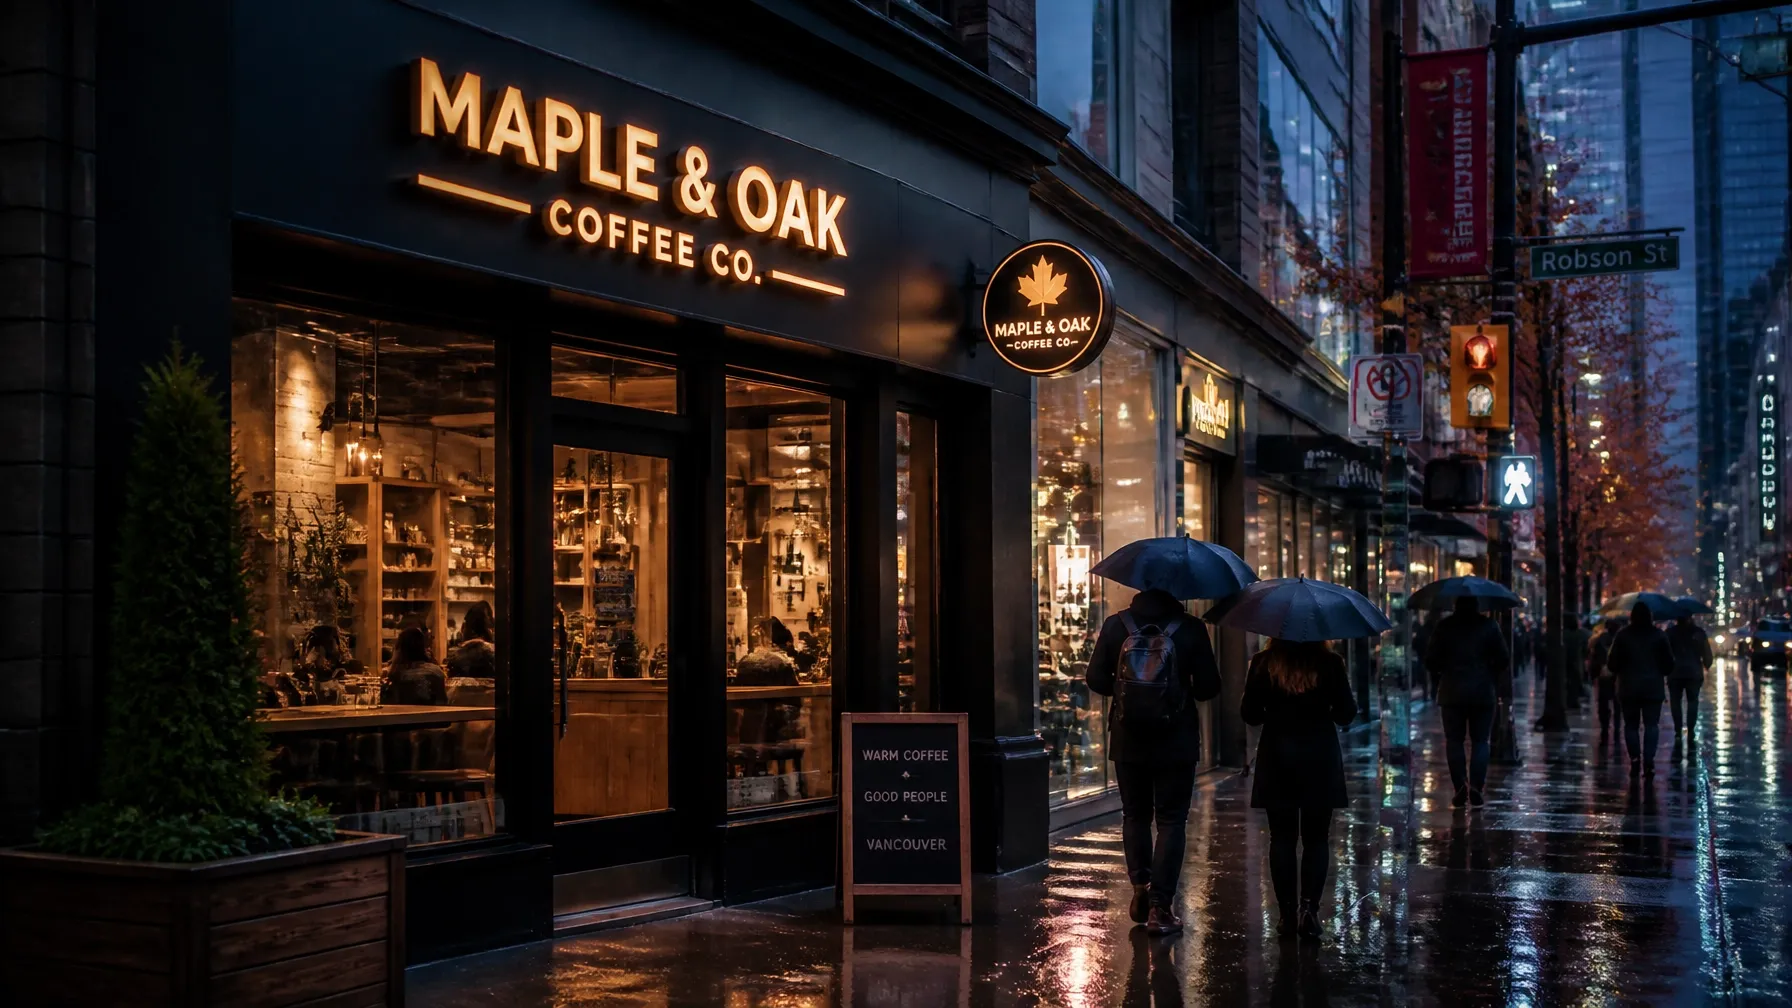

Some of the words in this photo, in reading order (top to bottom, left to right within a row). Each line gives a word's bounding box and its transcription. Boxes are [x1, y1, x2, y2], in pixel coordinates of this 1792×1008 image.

[418, 57, 659, 202] MAPLE
[677, 145, 718, 219] &
[734, 165, 848, 257] OAK
[547, 199, 695, 268] COFFEE
[709, 243, 761, 285] CO.
[1542, 249, 1632, 272] Robson
[1644, 245, 1668, 264] St
[995, 321, 1042, 337] MAPLE
[1045, 320, 1056, 334] &
[1059, 316, 1091, 333] OAK
[1014, 339, 1052, 350] COFFEE
[862, 750, 899, 761] WARM
[904, 750, 949, 761] COFFEE
[864, 791, 899, 802] GOOD
[903, 791, 948, 802] PEOPLE
[867, 838, 948, 850] VANCOUVER
